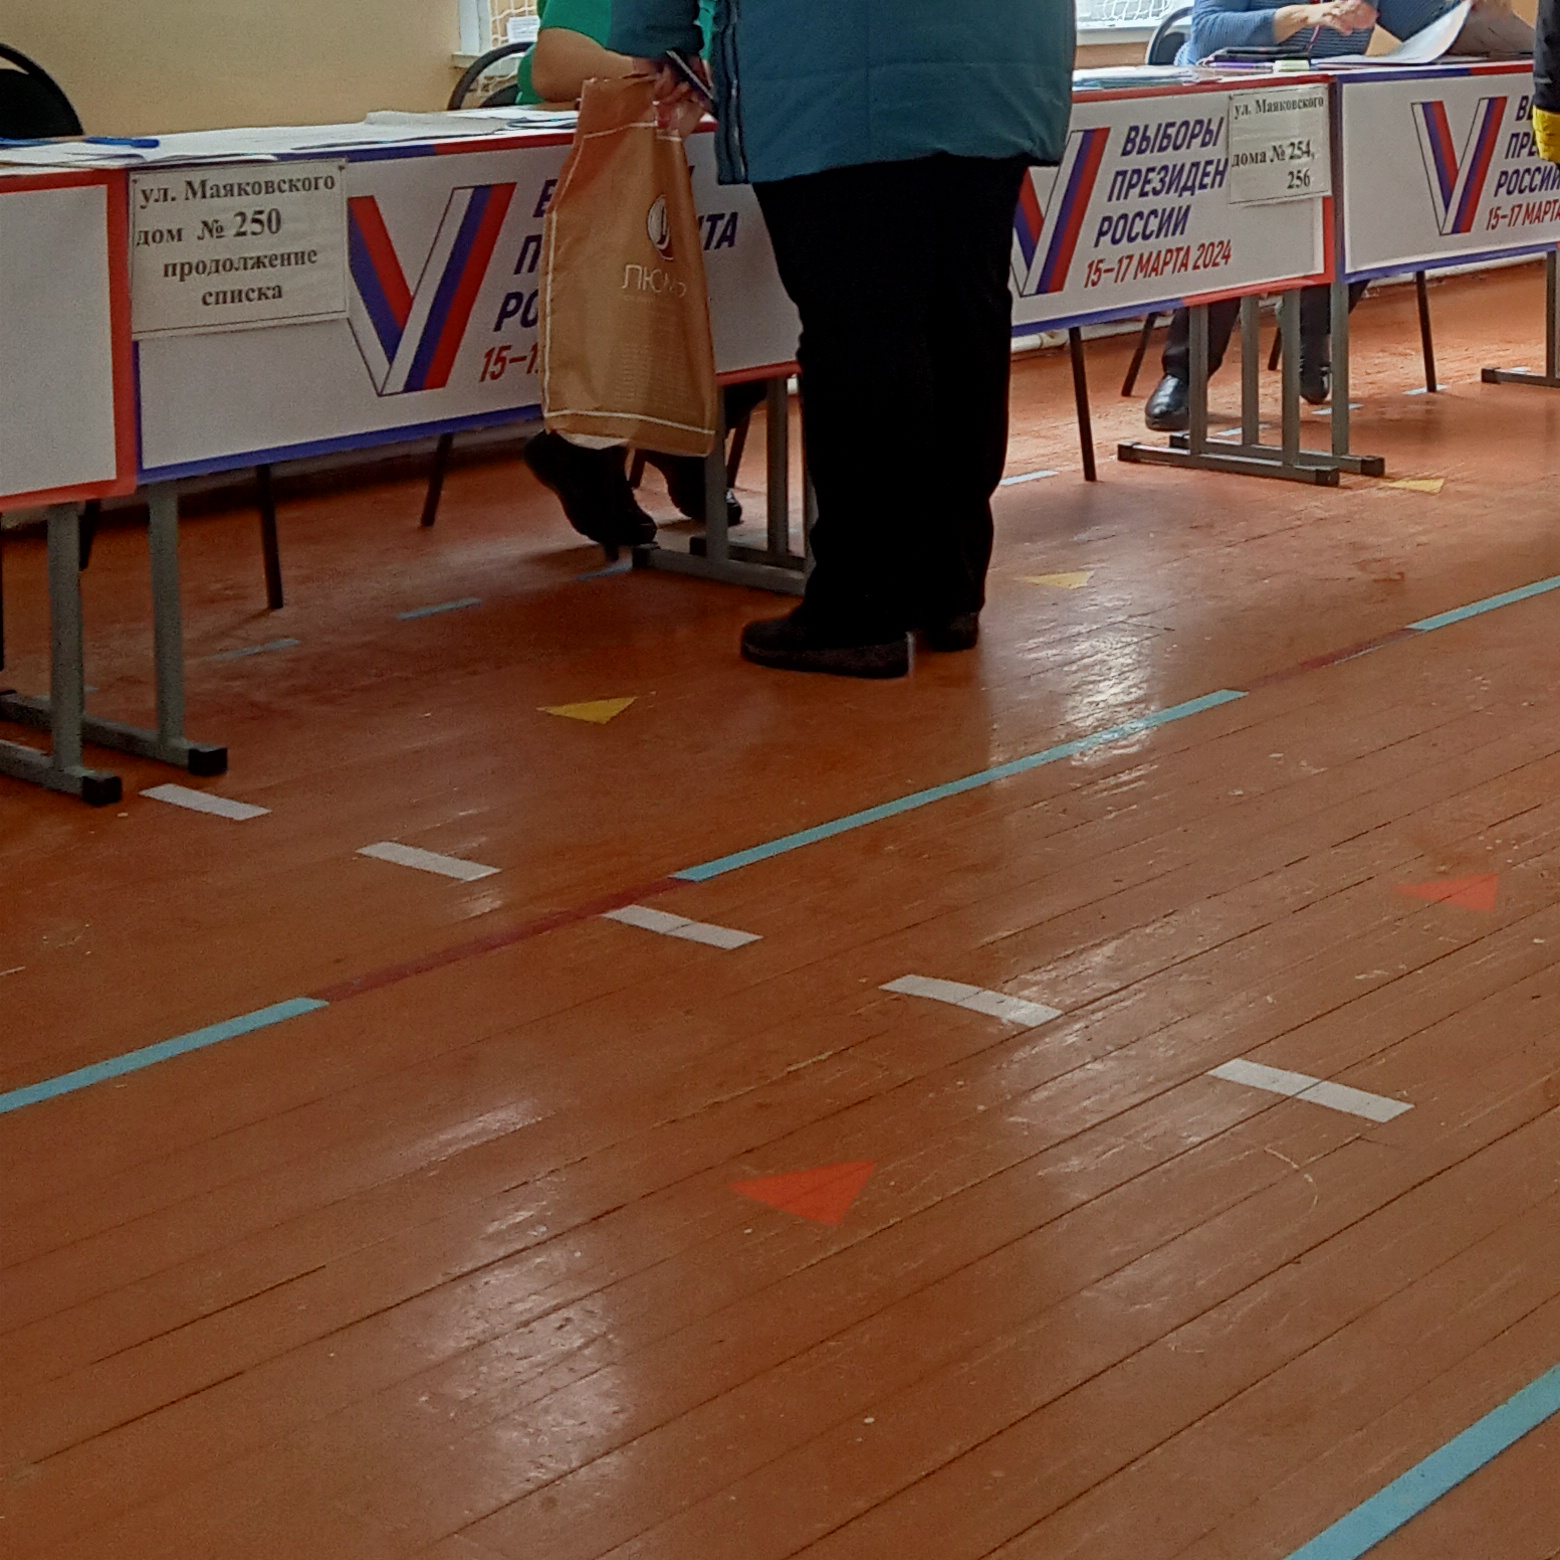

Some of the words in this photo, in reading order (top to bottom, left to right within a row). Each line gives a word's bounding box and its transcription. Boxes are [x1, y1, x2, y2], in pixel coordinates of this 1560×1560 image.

[1234, 103, 1251, 120] ул.
[1254, 96, 1324, 115] Маяковского
[1120, 116, 1225, 157] ВЫБОРЫ
[1231, 150, 1267, 168] дома
[1269, 144, 1286, 164] №
[140, 186, 177, 209] ул.
[184, 174, 336, 201] Маяковского
[1107, 157, 1228, 203] ПРЕЗИДЕН
[1286, 168, 1312, 190] 256
[136, 226, 183, 246] дом
[197, 219, 225, 241] №
[233, 207, 282, 238] 250
[1094, 204, 1191, 248] РОССИИ
[162, 248, 318, 282] продолжение
[1133, 245, 1190, 282] МАРТА
[1192, 239, 1233, 272] 2024
[201, 284, 283, 307] списка
